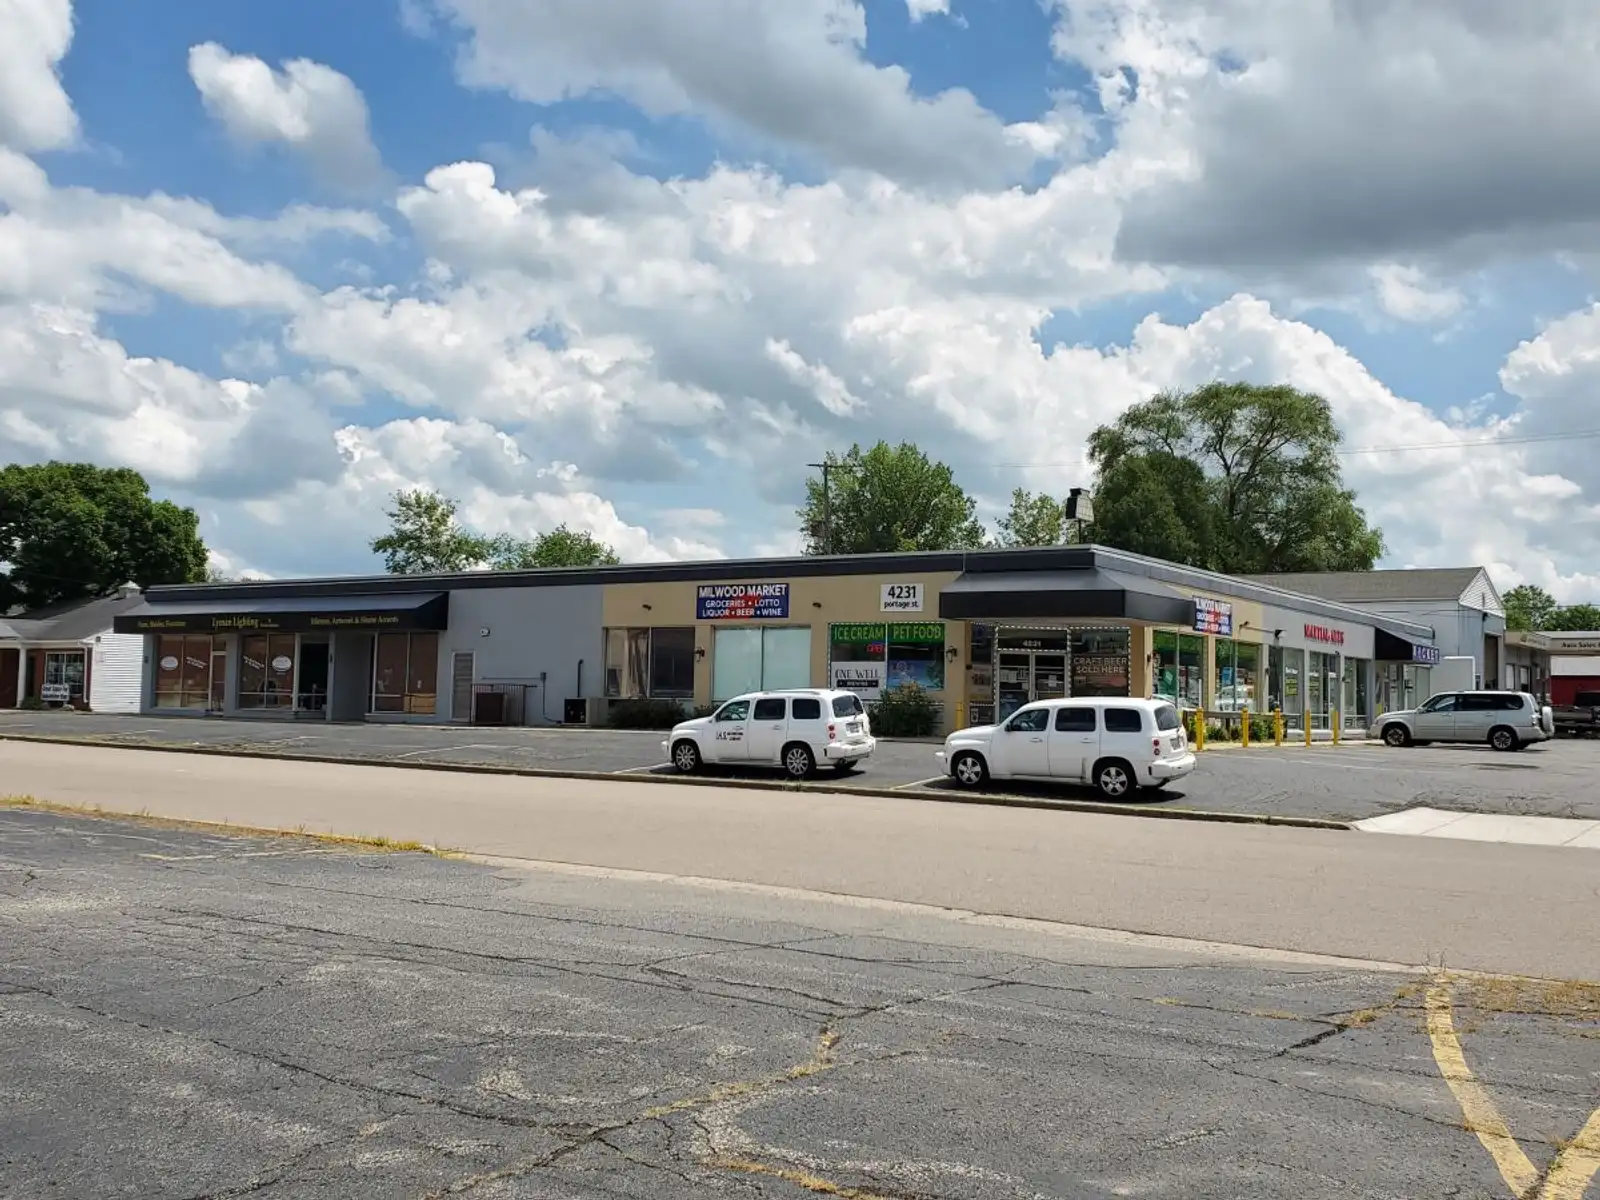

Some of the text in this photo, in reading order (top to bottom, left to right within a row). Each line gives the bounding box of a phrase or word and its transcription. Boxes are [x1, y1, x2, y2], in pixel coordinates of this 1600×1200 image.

[699, 584, 787, 598] MILWOOD MARKET
[888, 585, 917, 599] 4231
[705, 599, 780, 608] GROCERIES LOTTO
[884, 600, 911, 609] portage
[702, 608, 783, 617] LIQUOR BEER WINE
[233, 616, 259, 630] Lighting
[834, 626, 884, 640] ICE CREAM
[893, 625, 942, 639] PET FOOD
[1073, 657, 1127, 665] CRAFT BEER
[835, 669, 879, 679] ONE WELL
